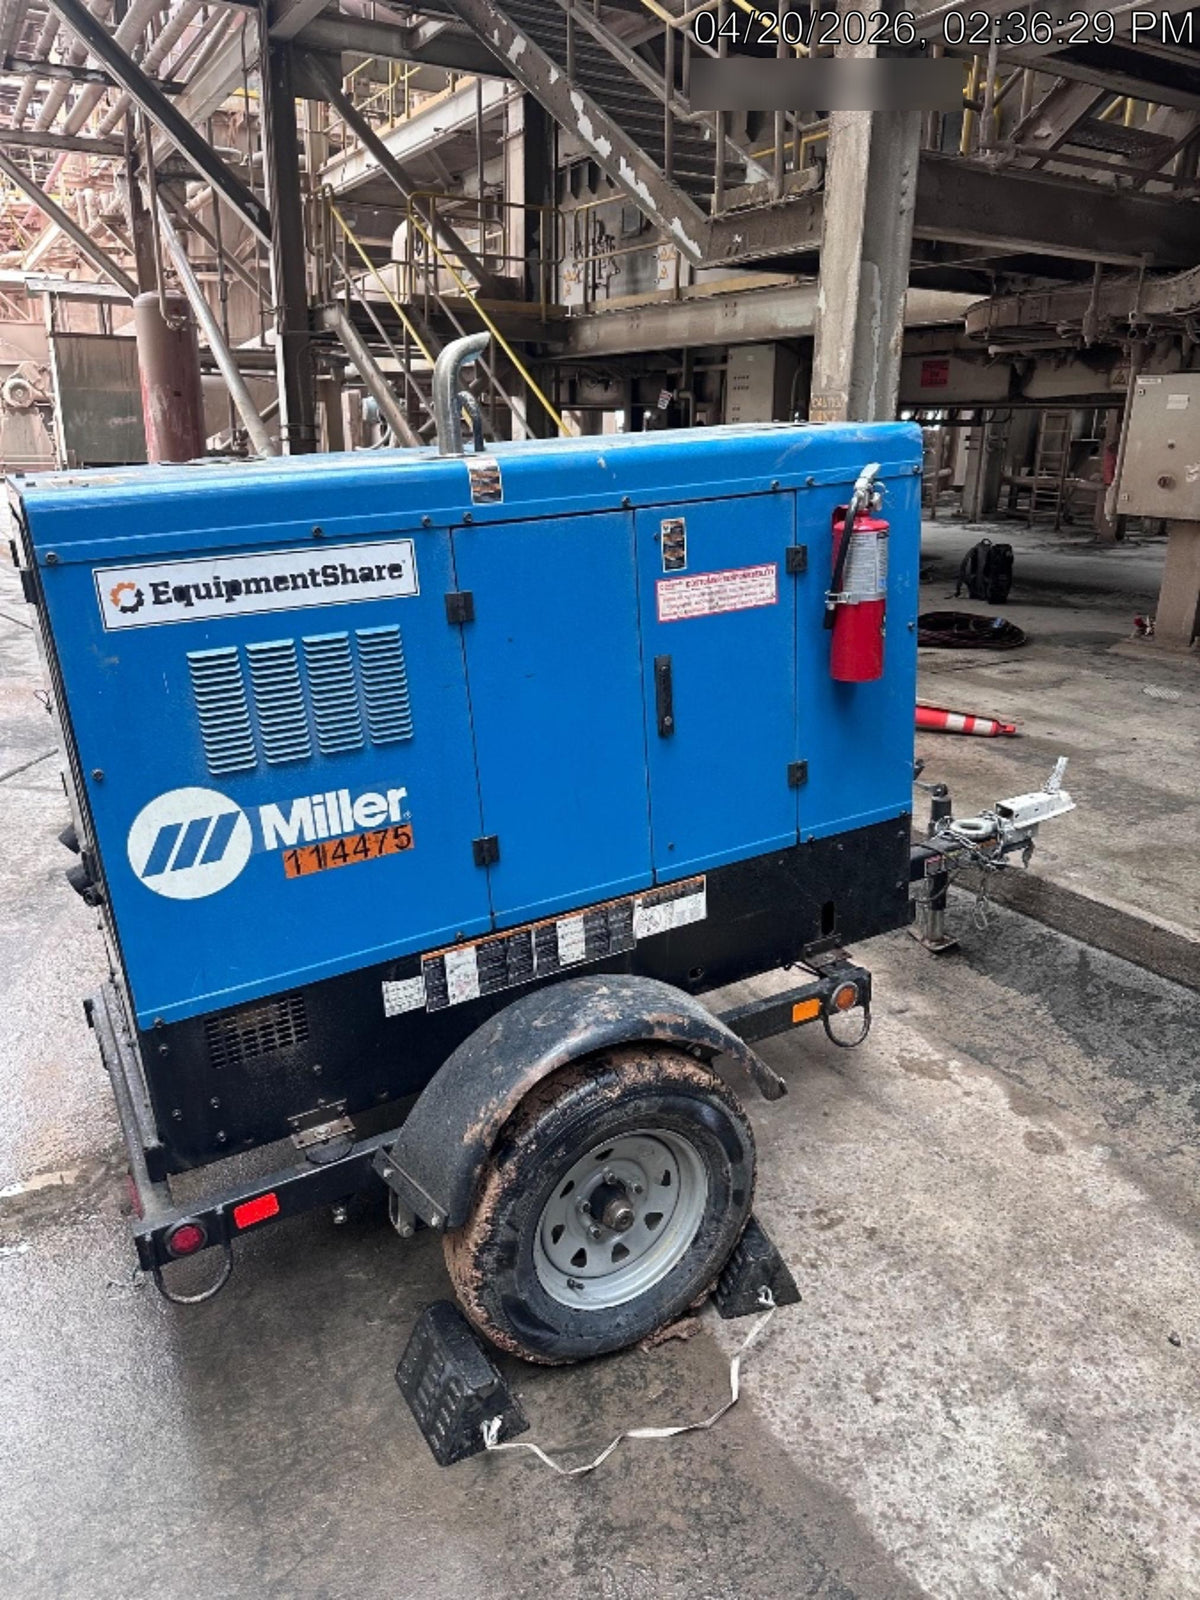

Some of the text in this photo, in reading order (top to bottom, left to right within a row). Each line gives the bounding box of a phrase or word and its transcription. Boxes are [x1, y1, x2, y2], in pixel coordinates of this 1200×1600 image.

[149, 561, 405, 607] EquipmentShare
[259, 787, 408, 851] Miller
[285, 824, 412, 875] 114475
